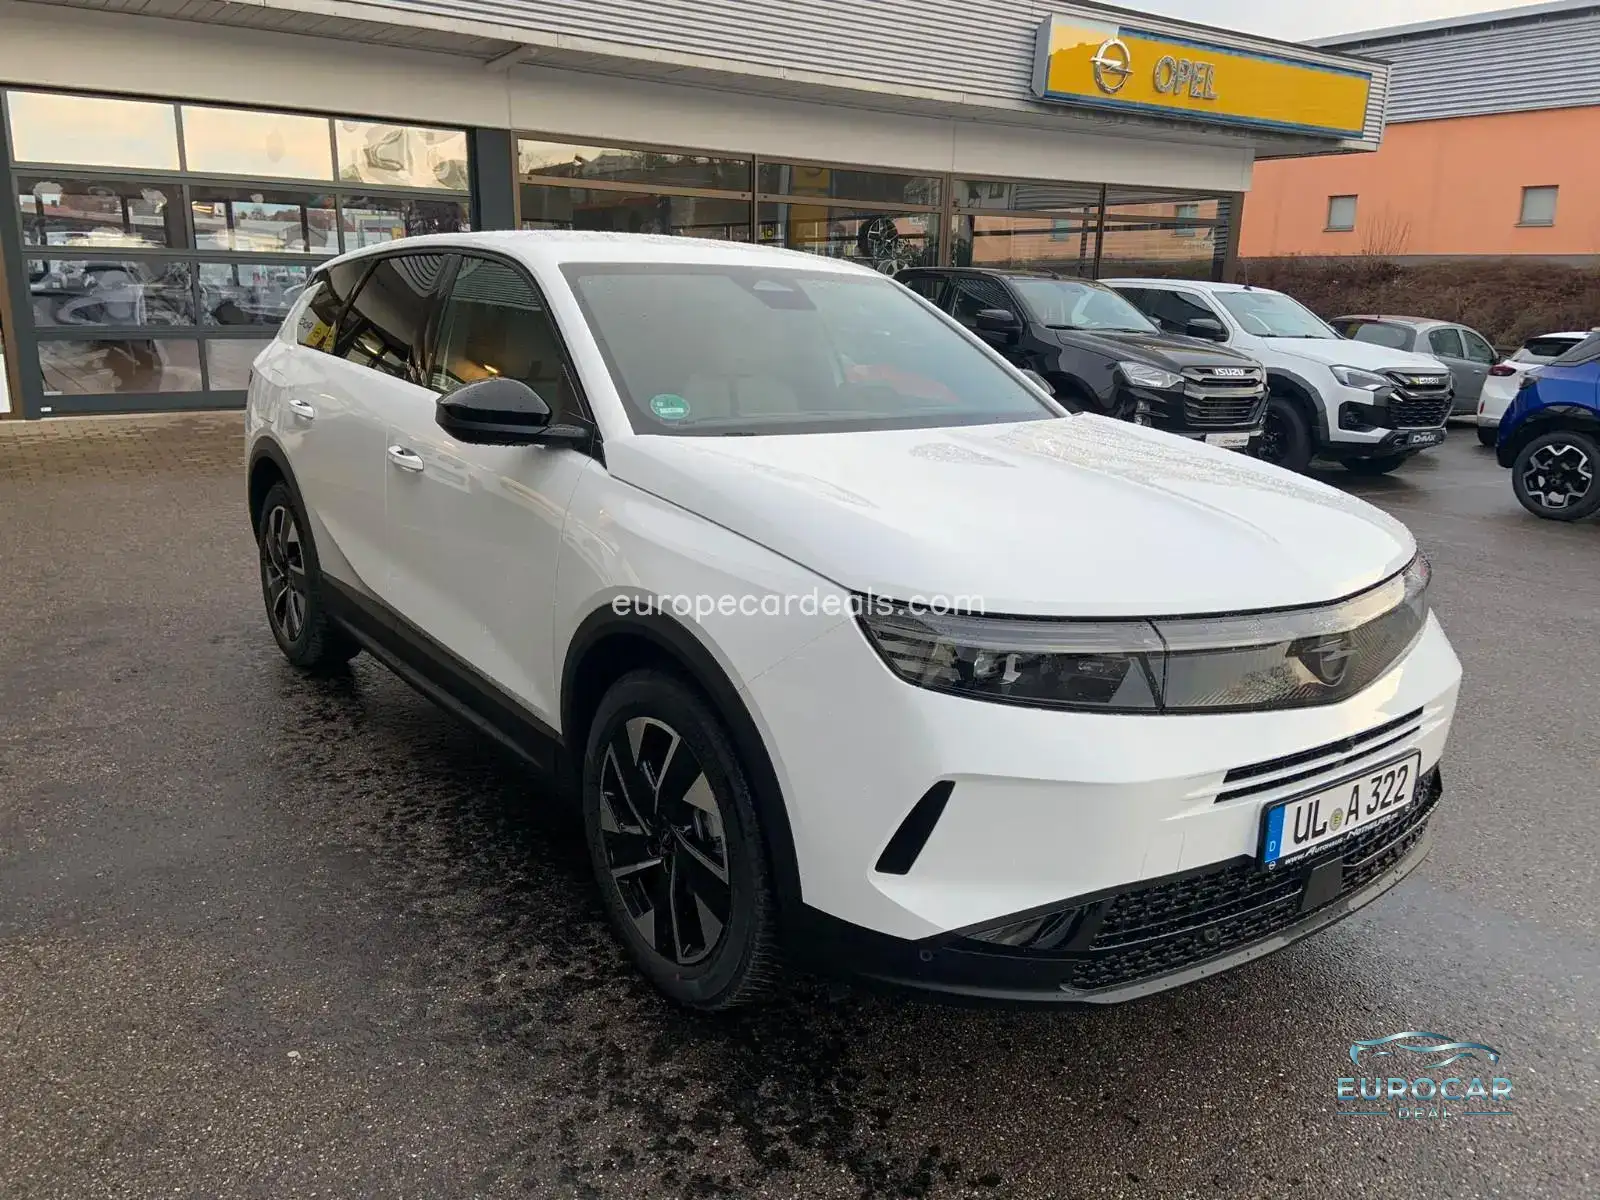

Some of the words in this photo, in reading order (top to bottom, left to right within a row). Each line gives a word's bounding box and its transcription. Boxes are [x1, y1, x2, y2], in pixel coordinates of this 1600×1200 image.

[1153, 55, 1217, 100] OPEL
[1215, 368, 1244, 376] ISUZU
[1293, 799, 1328, 845] UL
[1345, 784, 1360, 825] A
[1366, 764, 1409, 815] 322
[1269, 840, 1276, 852] D
